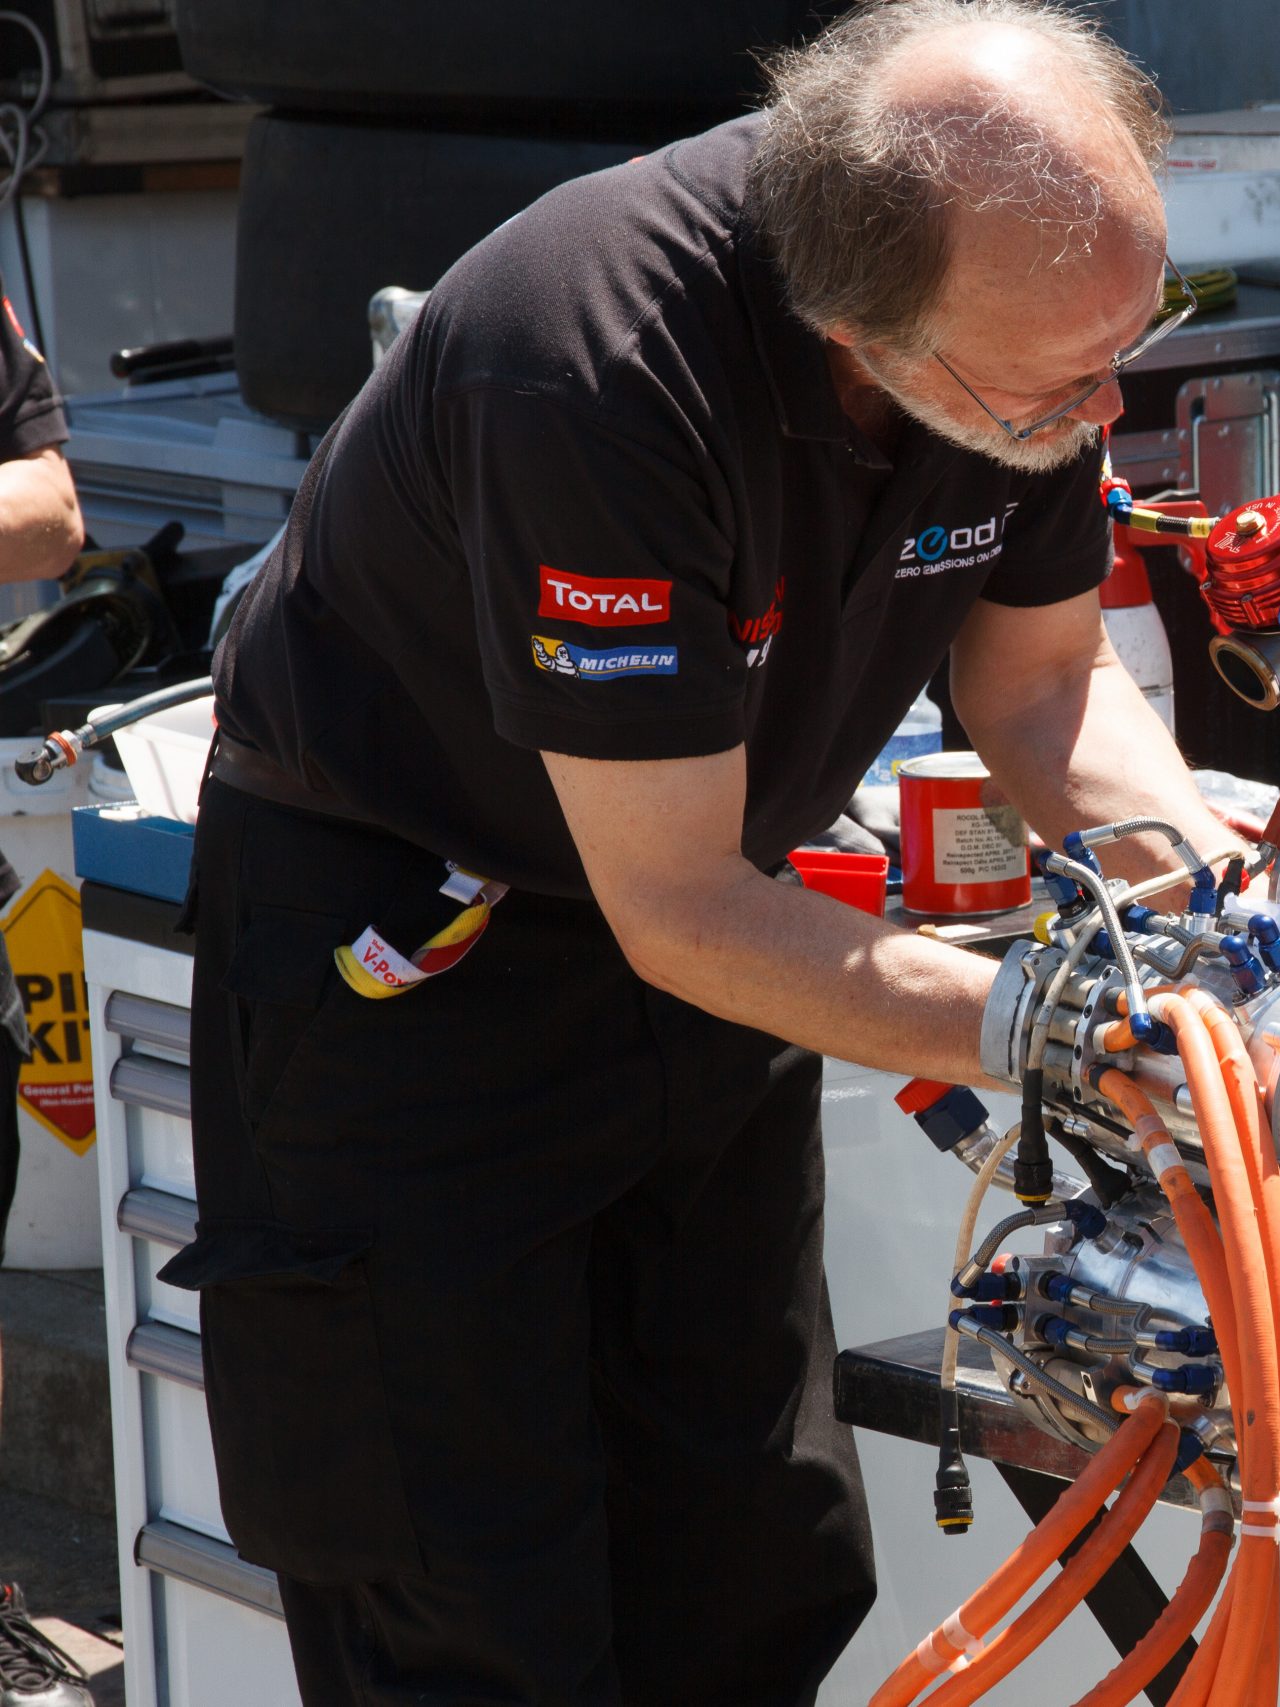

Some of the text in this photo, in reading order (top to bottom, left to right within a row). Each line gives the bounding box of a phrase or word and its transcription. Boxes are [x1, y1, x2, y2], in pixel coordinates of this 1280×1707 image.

[894, 567, 921, 579] ZERO
[922, 555, 975, 576] EMISSIONS
[976, 552, 989, 564] ON
[546, 578, 663, 614] TOTAL
[578, 654, 675, 671] MICHELIN
[22, 1020, 92, 1064] KI
[23, 1085, 70, 1097] General
